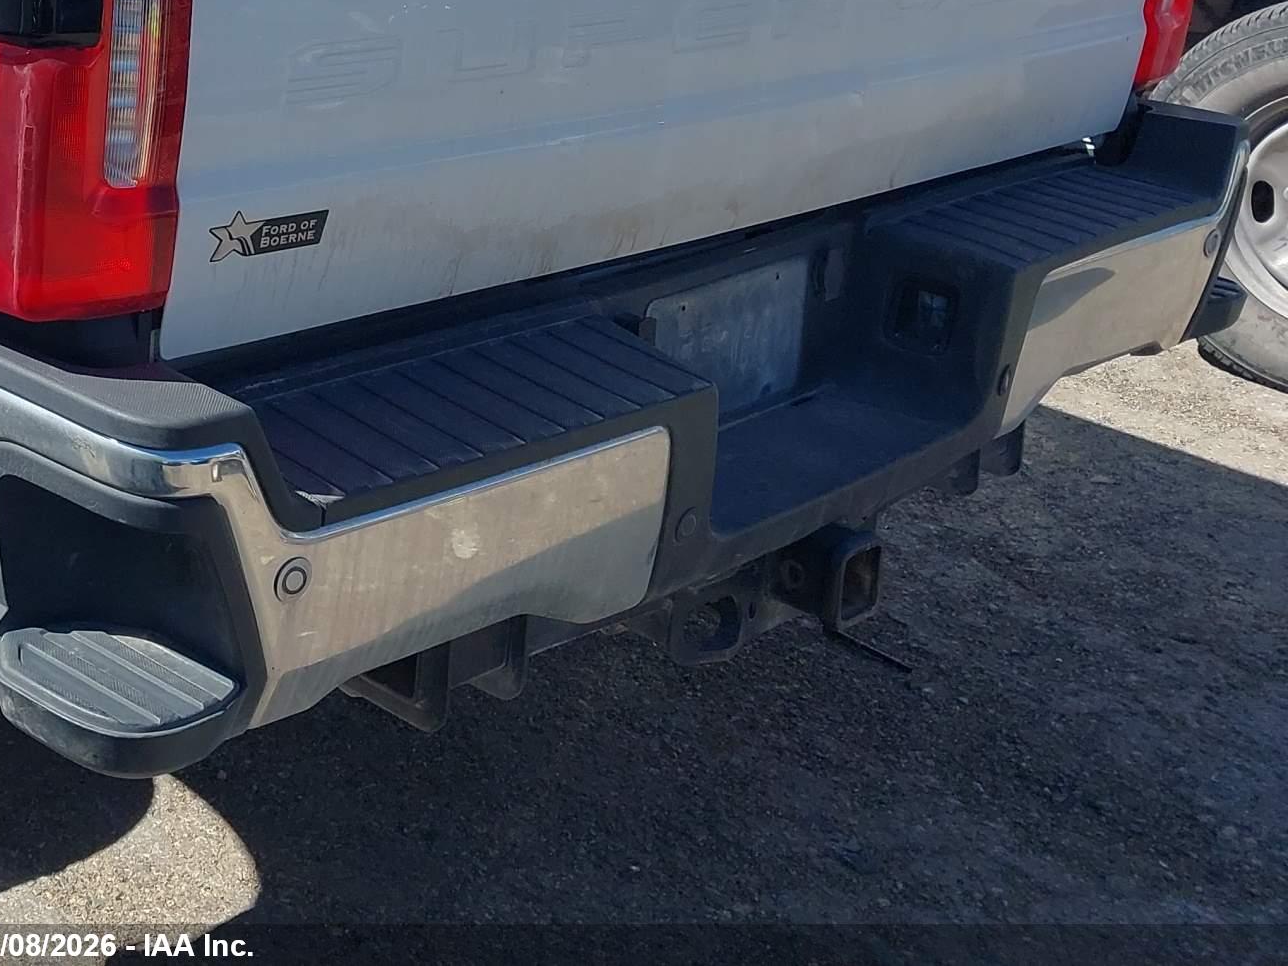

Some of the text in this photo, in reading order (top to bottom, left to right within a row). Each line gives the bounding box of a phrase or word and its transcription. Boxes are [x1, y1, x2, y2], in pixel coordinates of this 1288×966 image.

[261, 219, 318, 237] FORD OF
[260, 230, 316, 248] BOERNE
